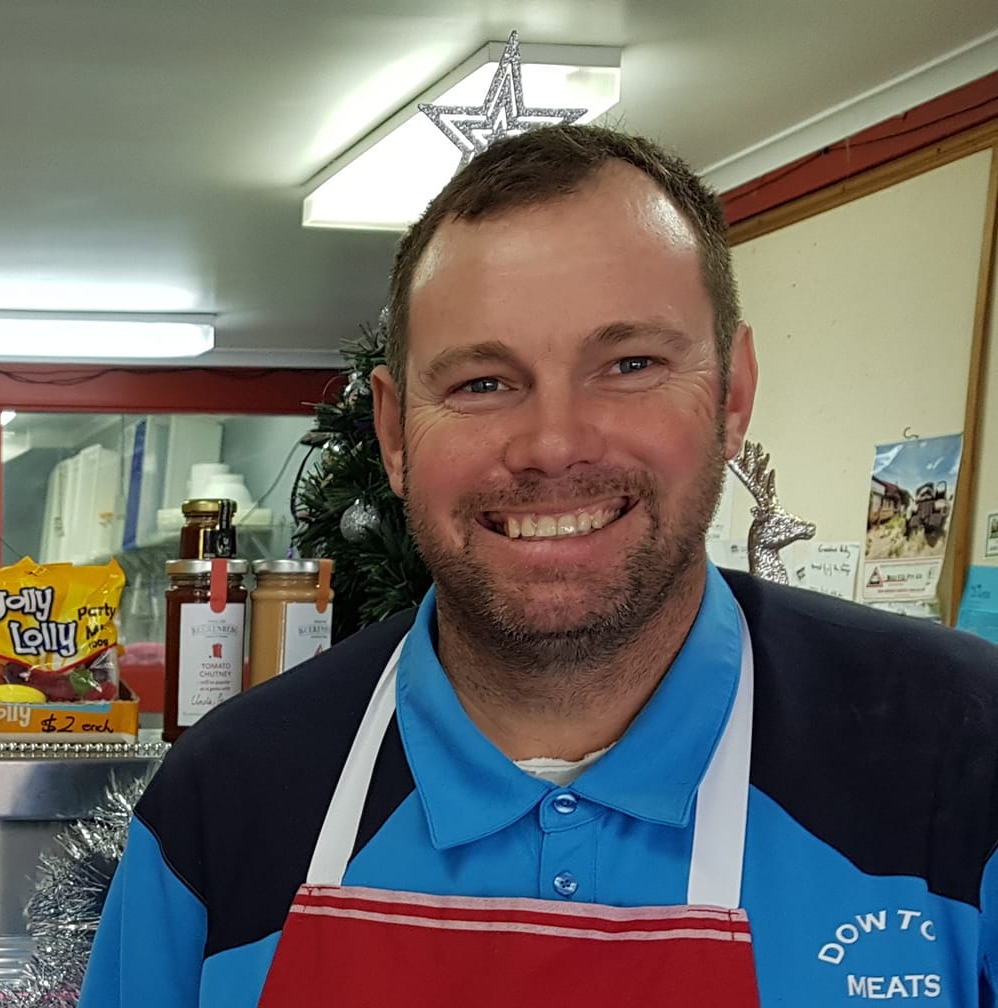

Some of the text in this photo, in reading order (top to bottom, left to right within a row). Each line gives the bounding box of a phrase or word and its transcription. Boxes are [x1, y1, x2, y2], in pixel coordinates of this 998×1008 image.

[9, 620, 77, 657] Lolly
[199, 670, 232, 678] CHUTNEY
[201, 662, 231, 670] TOMATO
[41, 714, 75, 733] $2
[847, 974, 941, 999] MEATS
